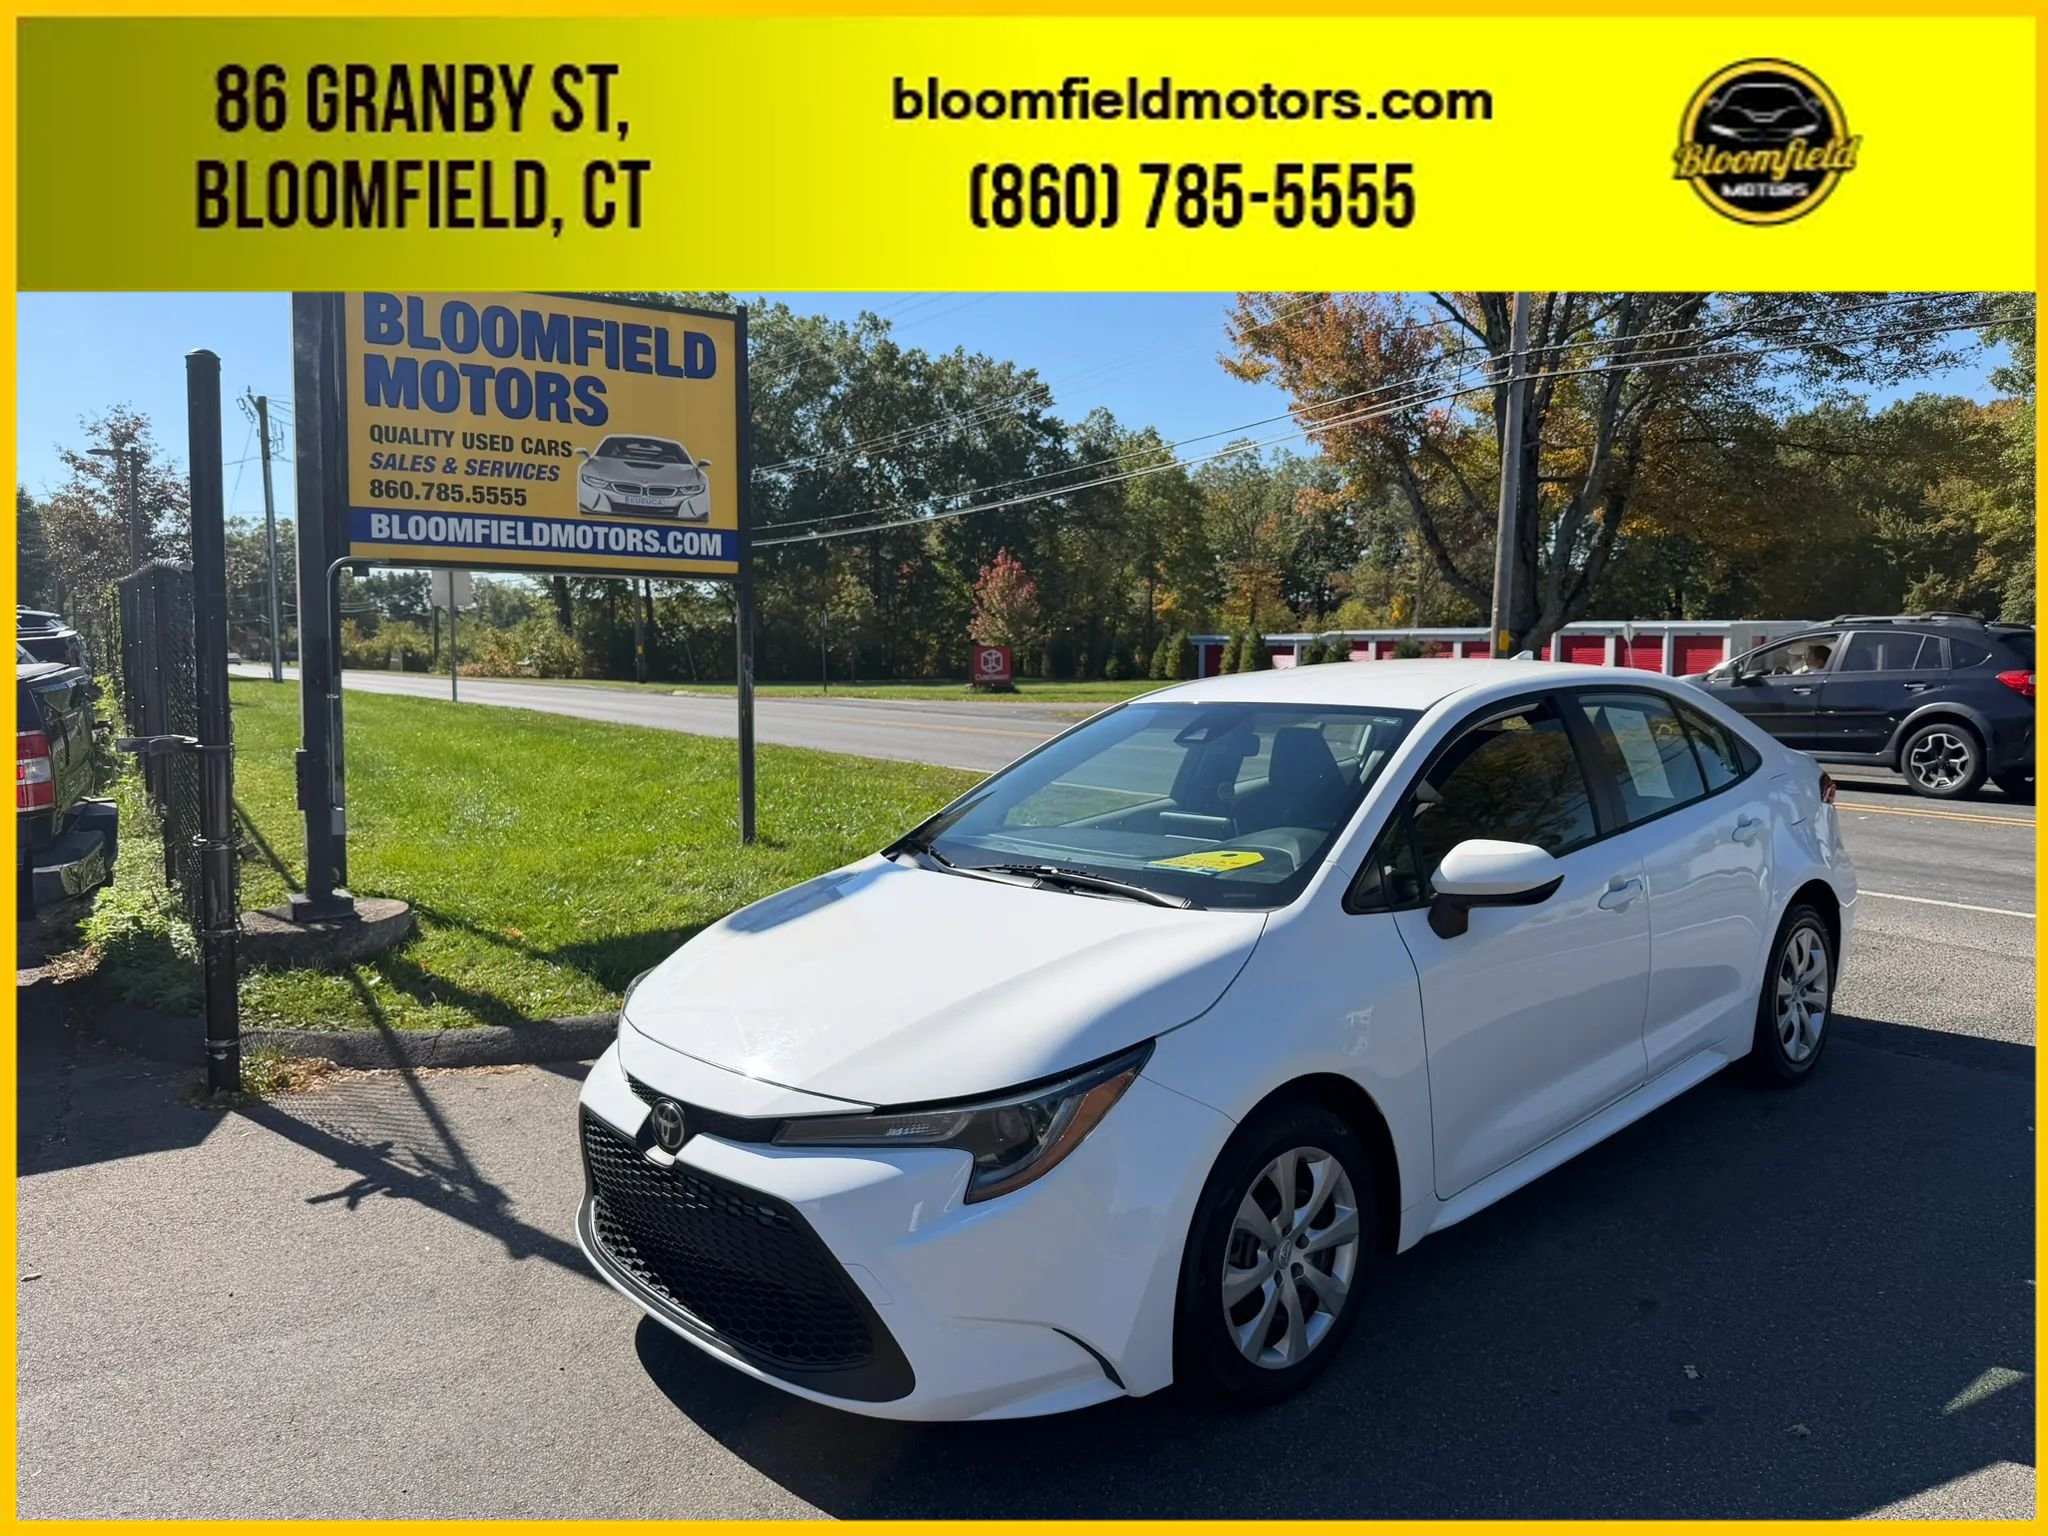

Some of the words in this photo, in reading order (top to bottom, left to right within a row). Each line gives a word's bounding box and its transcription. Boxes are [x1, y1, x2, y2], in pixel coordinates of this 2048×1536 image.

[363, 291, 717, 380] BLOOMFIELD
[363, 353, 609, 427] MOTORS
[369, 424, 455, 449] QUALITY
[462, 431, 514, 453] USED
[521, 437, 573, 458] CARS
[369, 452, 437, 475] SALES
[442, 456, 459, 476] &
[464, 457, 561, 482] SERVICES
[369, 479, 528, 507] 860.785.5555
[370, 513, 722, 557] BLOOMFIELDMOTORS.COM
